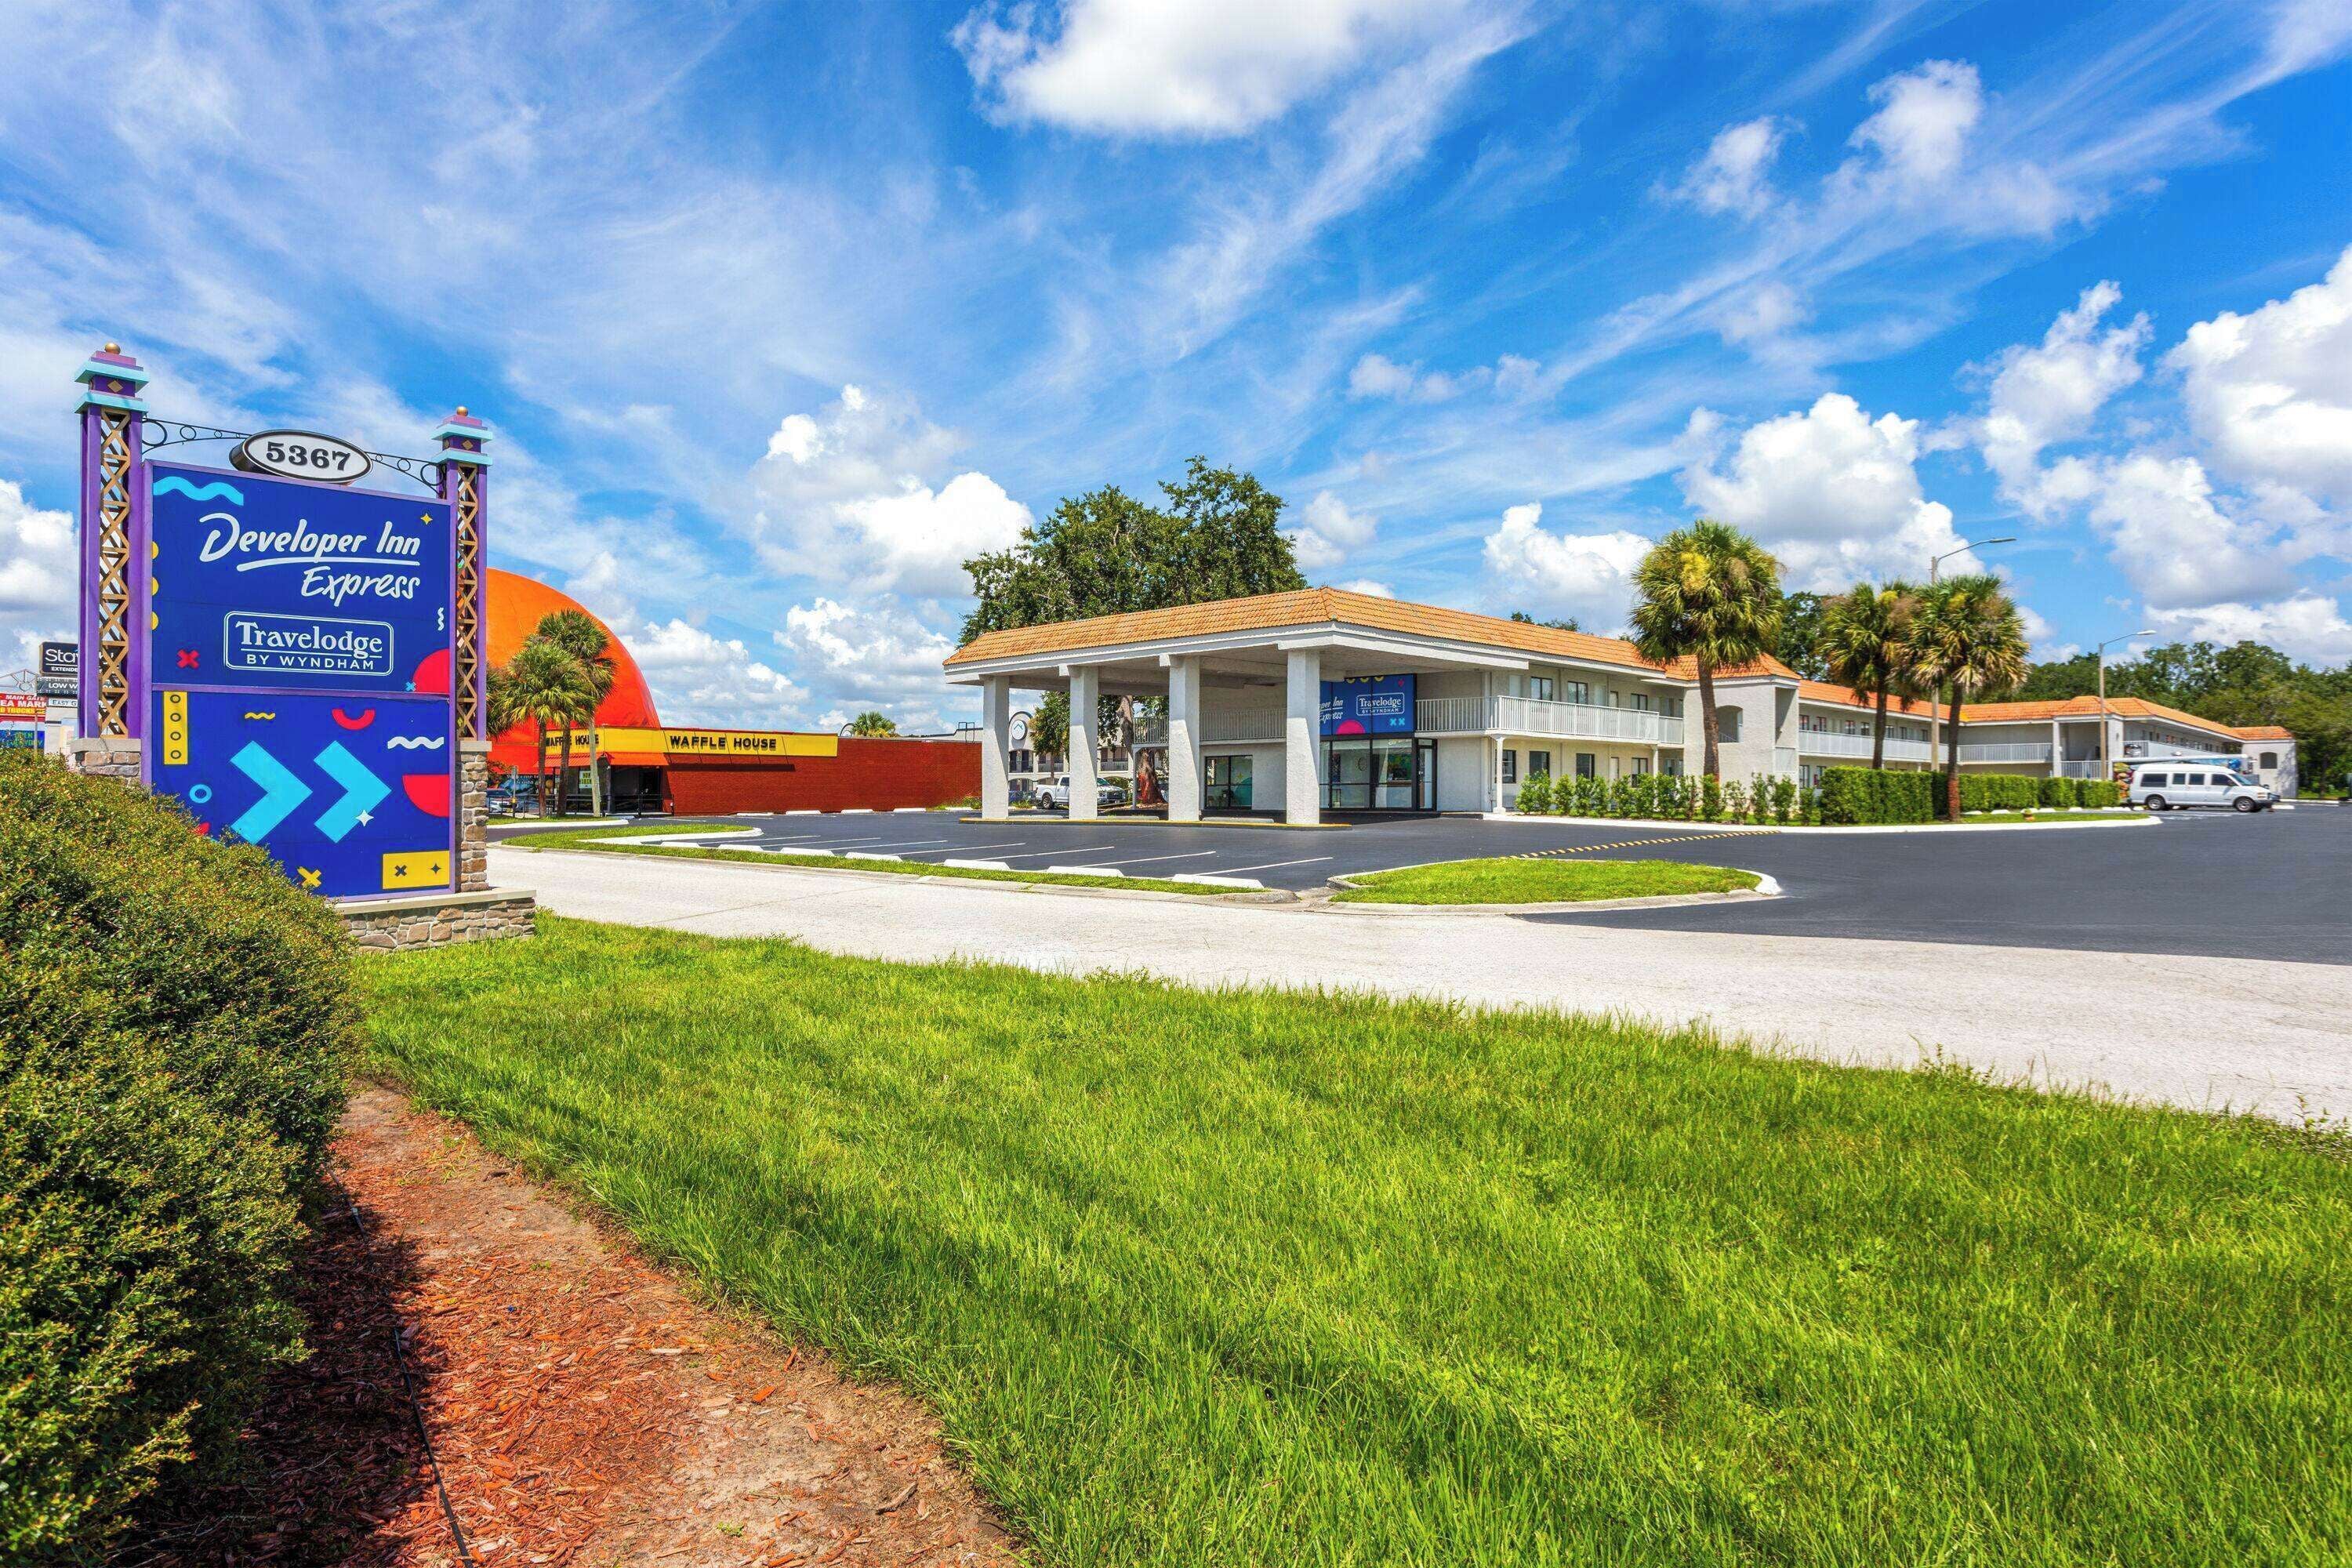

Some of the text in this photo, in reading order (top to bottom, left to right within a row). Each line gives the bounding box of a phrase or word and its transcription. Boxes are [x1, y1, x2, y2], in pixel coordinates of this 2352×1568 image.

[265, 441, 351, 471] 5367
[199, 512, 421, 564] Developer Inn
[300, 565, 420, 607] Express
[235, 621, 383, 659] Travelodge
[247, 654, 374, 670] BY WYNDHAM
[1333, 696, 1343, 706] Inn
[1359, 697, 1402, 708] Travelodge
[575, 734, 599, 746] HOUE
[670, 735, 776, 749] WAFFLE HOUSE
